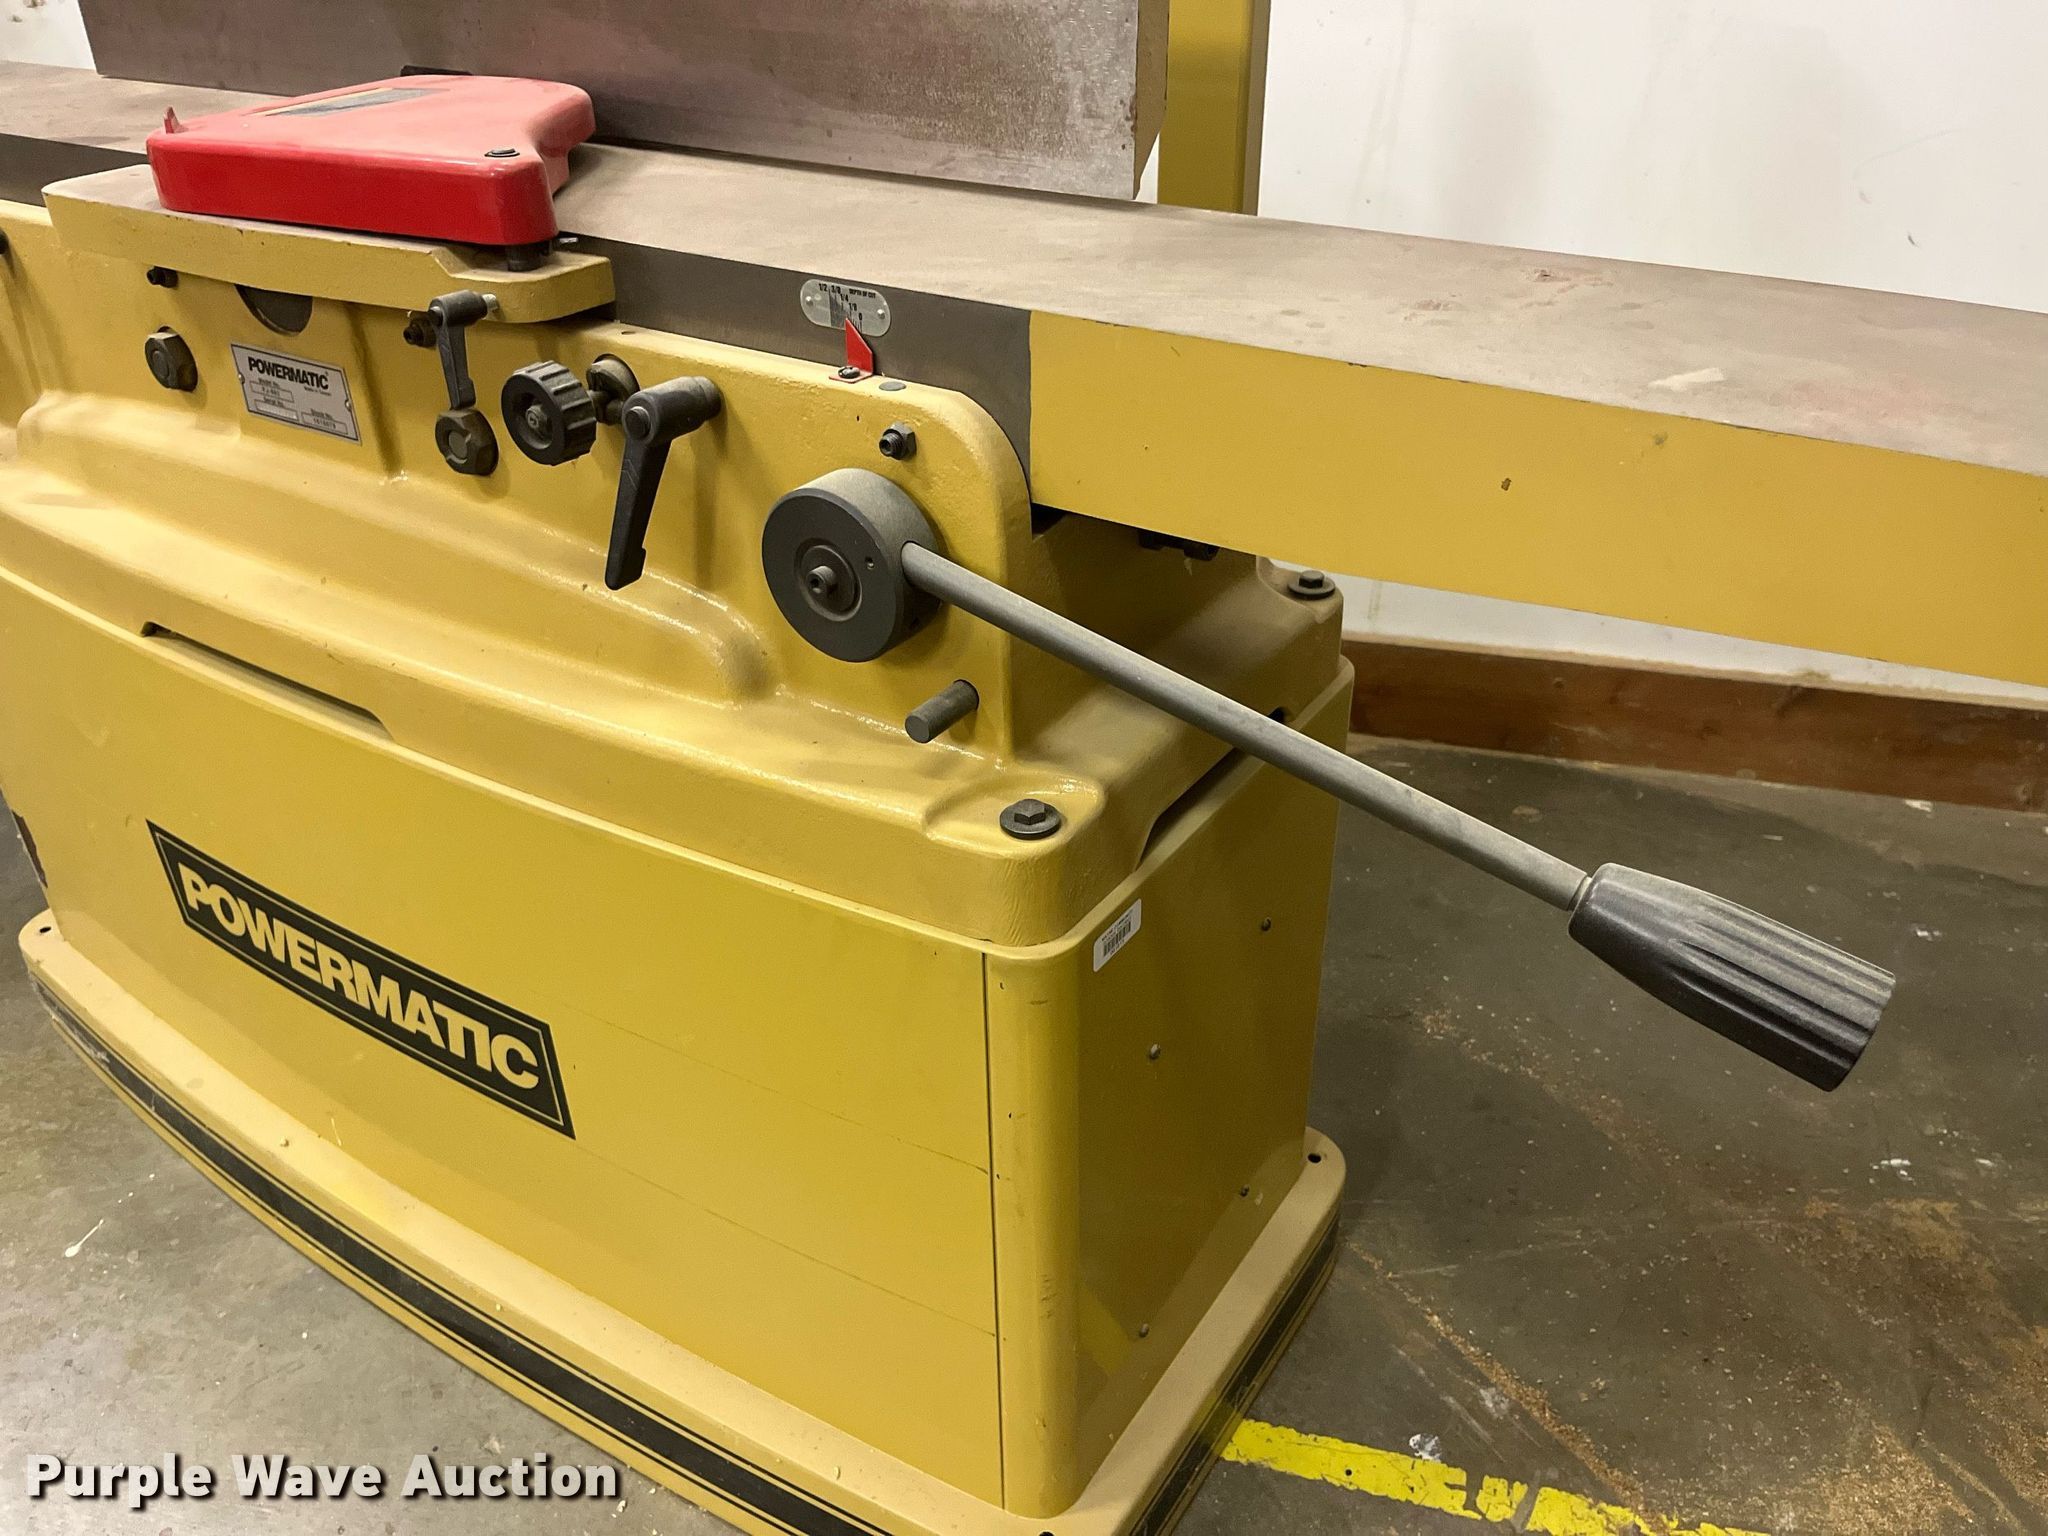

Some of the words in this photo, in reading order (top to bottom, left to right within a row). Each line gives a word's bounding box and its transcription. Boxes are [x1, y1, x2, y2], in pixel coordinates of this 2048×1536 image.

[818, 283, 828, 292] 1/2
[840, 293, 849, 302] 1/4
[248, 356, 329, 390] POWERMATIC
[178, 862, 539, 1089] POWERMATIC
